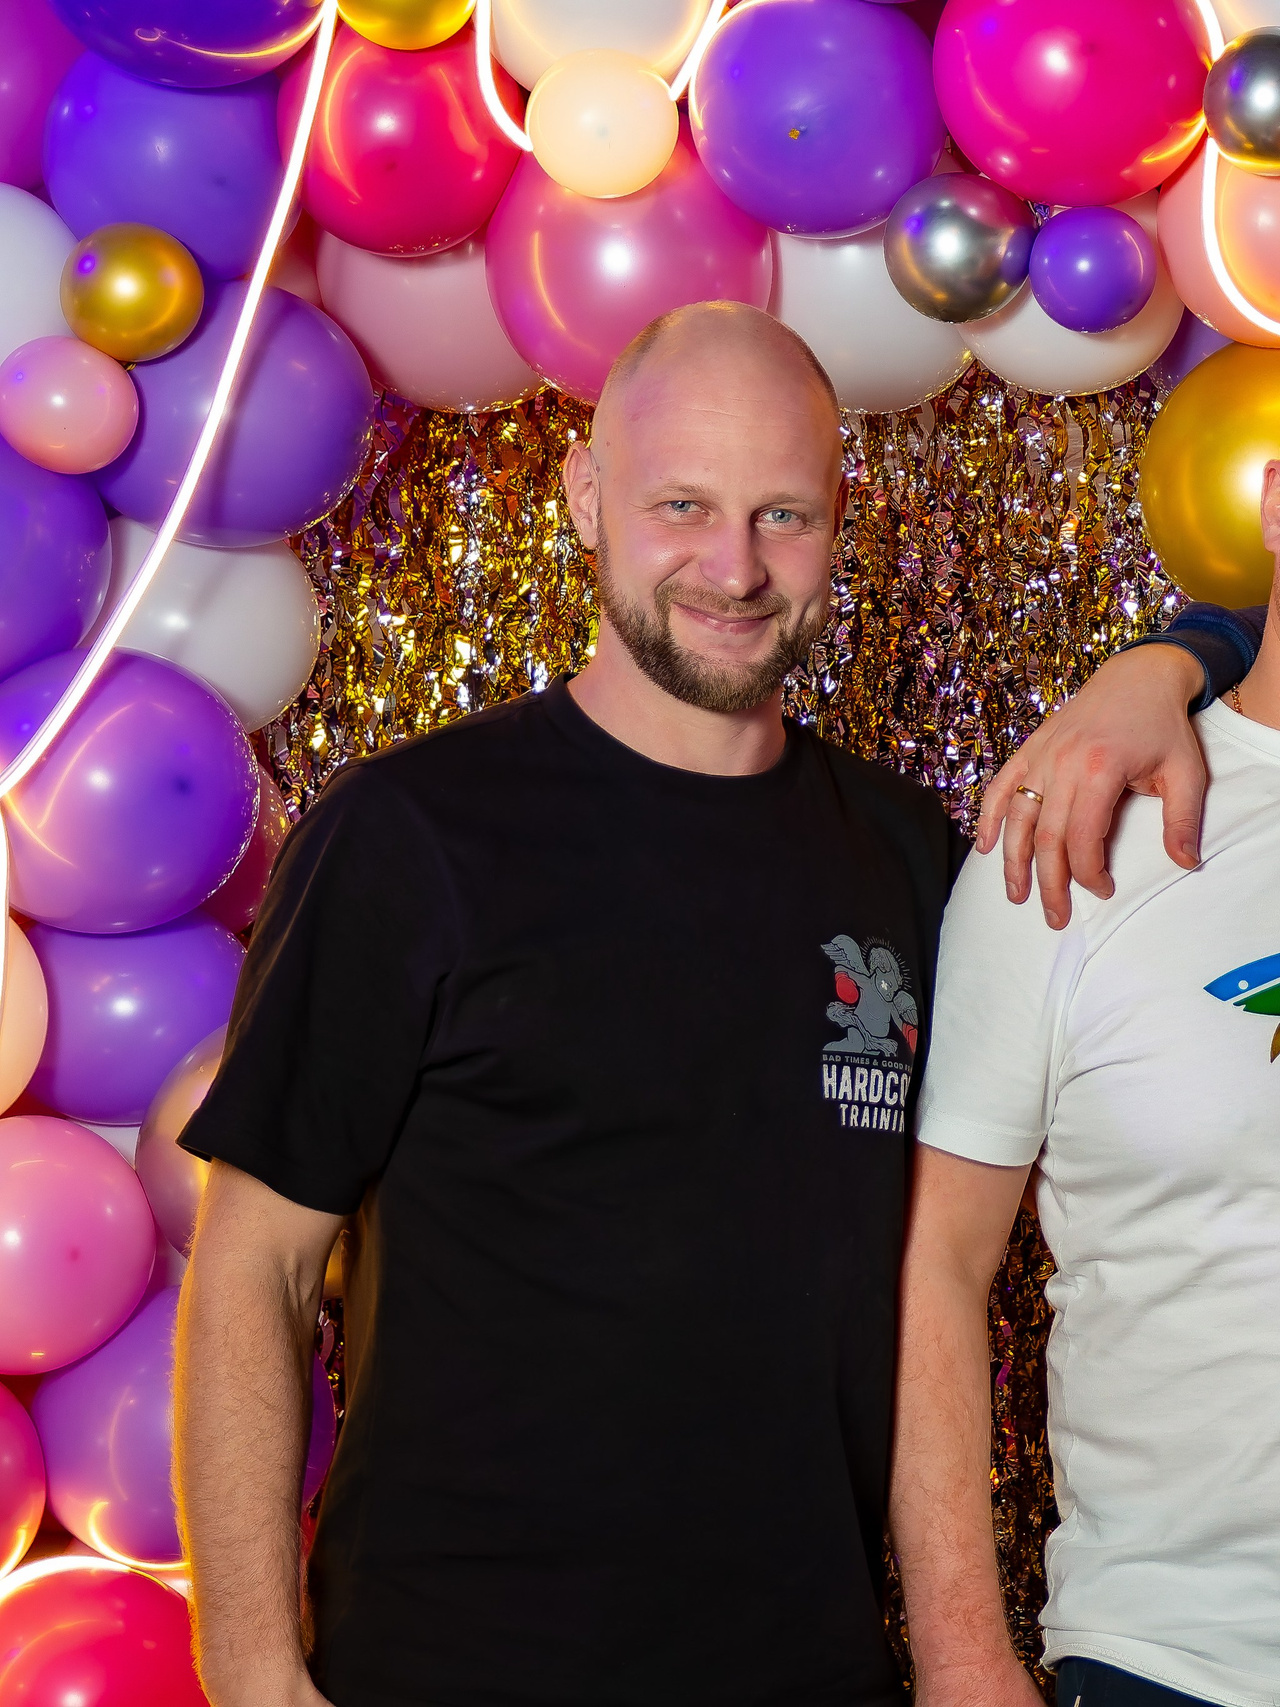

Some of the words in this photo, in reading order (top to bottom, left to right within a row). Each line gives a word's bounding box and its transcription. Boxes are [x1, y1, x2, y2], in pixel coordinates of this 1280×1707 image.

[822, 1054, 842, 1062] BAD
[845, 1055, 870, 1065] TIMES
[872, 1059, 879, 1067] &
[881, 1060, 904, 1070] GOOD
[822, 1064, 911, 1107] HARDCO
